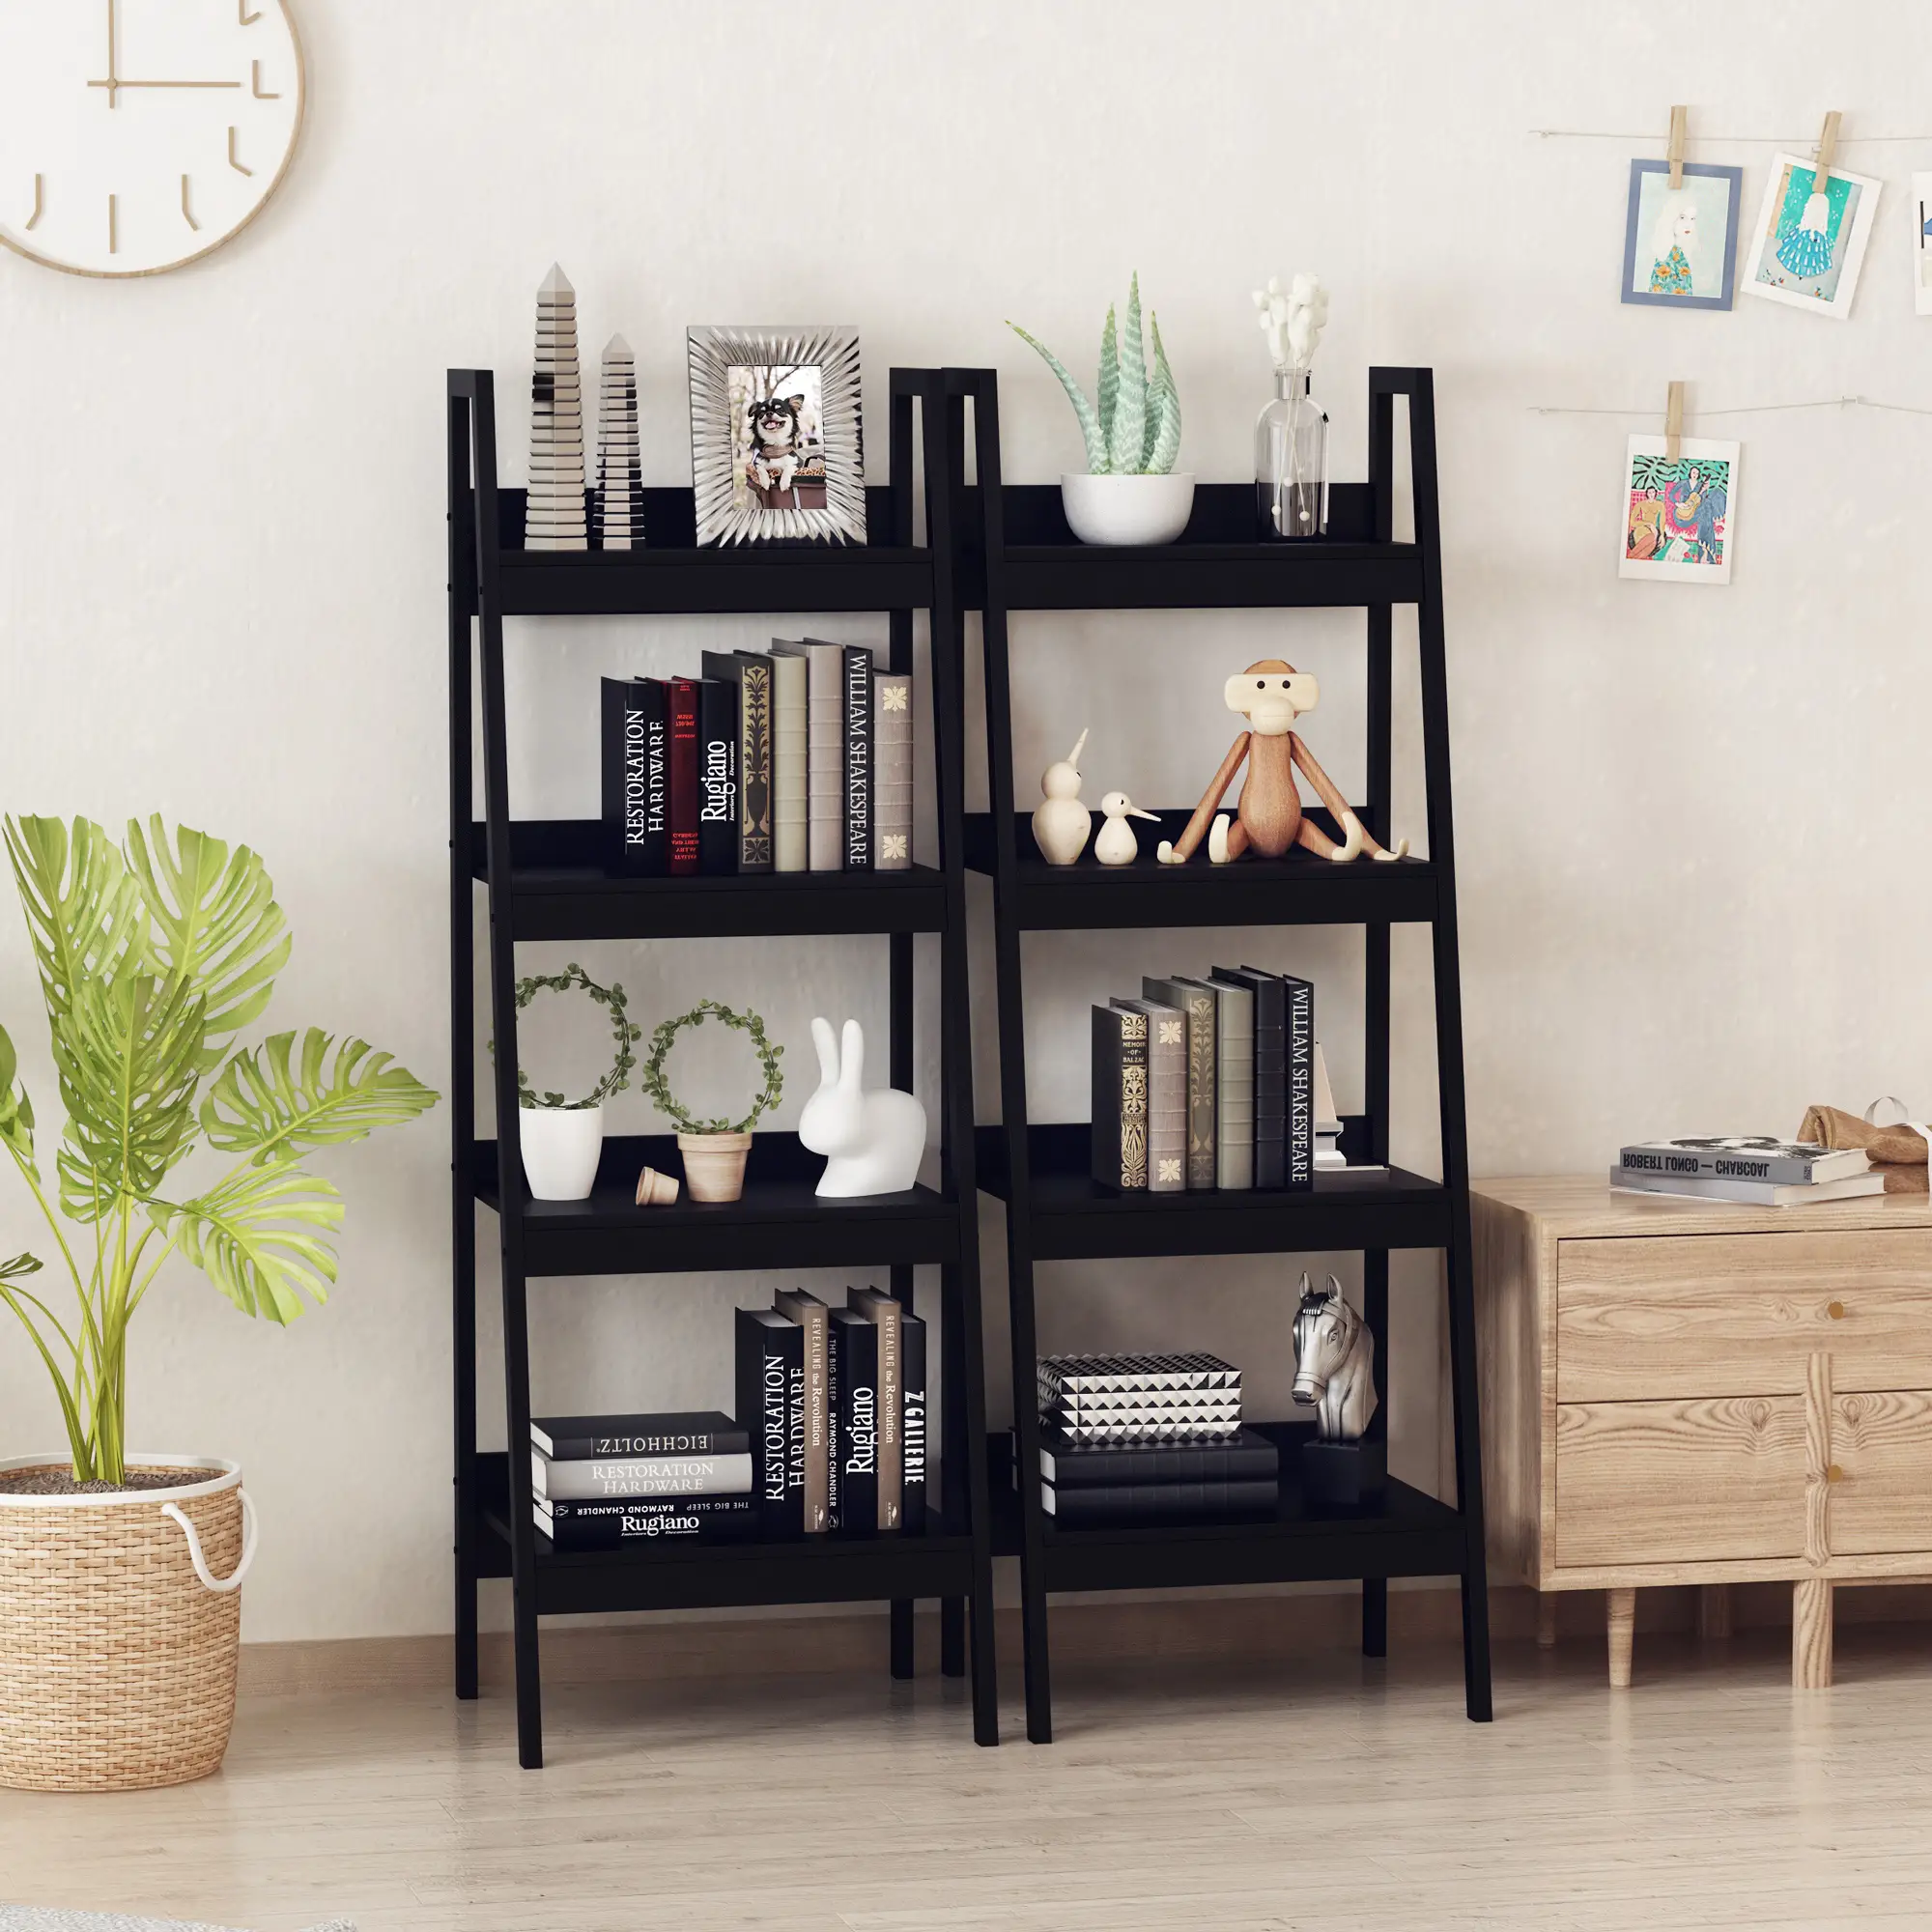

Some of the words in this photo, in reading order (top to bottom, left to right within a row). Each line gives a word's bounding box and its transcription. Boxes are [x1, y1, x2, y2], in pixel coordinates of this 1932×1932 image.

[850, 654, 867, 737] WILLIAM
[626, 709, 644, 845] RESTORATION
[648, 721, 664, 833] HARDWARE
[700, 740, 736, 822] Rugiano
[850, 742, 867, 866] SHAKESPEARE
[1293, 987, 1308, 1063] WILLIAM
[1292, 1068, 1308, 1181] SHAKESPEARE
[811, 1318, 821, 1370] REVEALING
[828, 1339, 837, 1355] THE
[885, 1315, 895, 1368] REVEALING
[811, 1373, 820, 1385] the
[828, 1357, 837, 1374] BIG
[828, 1377, 837, 1401] SLEEP
[885, 1370, 894, 1382] the
[811, 1387, 823, 1447] Revolution
[885, 1384, 897, 1444] Revolution
[904, 1390, 924, 1404] Z
[765, 1354, 784, 1502] RESTORATION
[788, 1366, 805, 1488] HARDWARE
[828, 1412, 838, 1459] RAYMOND
[845, 1386, 879, 1475] Rugiano
[592, 1463, 713, 1480] RESTORATION
[603, 1479, 703, 1493] HARDWARE
[828, 1461, 838, 1508] CHANDLER
[577, 1506, 625, 1517] CHANDLER
[620, 1514, 700, 1537] Rugiano
[627, 1504, 674, 1514] RAYMOND
[686, 1503, 711, 1512] SLEEP
[714, 1502, 730, 1511] BIG
[732, 1501, 750, 1510] THE
